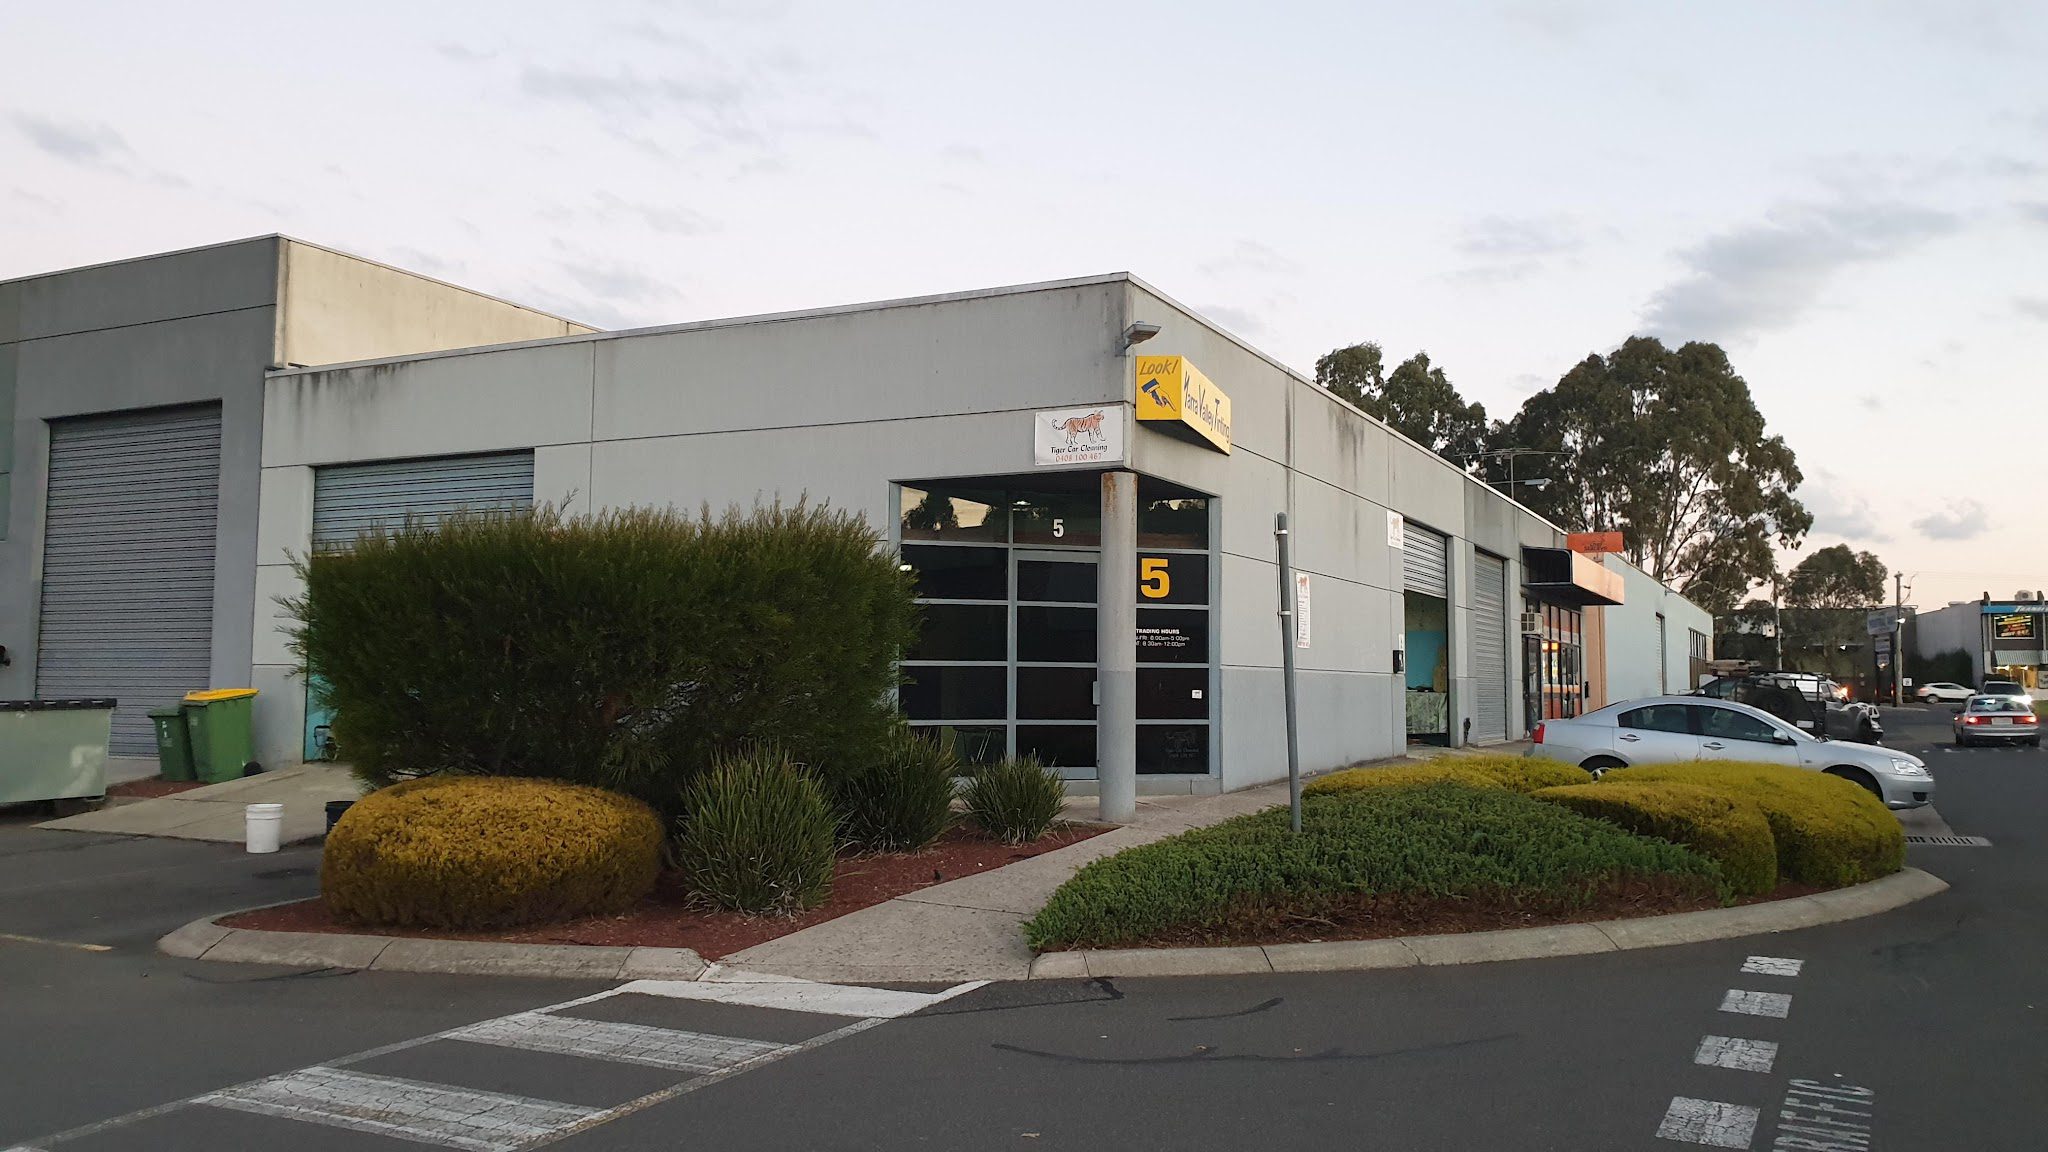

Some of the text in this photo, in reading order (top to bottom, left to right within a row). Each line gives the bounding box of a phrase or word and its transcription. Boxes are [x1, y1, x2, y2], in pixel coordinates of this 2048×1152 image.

[1051, 446, 1065, 455] Tiger
[1080, 444, 1108, 453] Cleaning
[1053, 519, 1064, 538] 5
[1141, 558, 1170, 598] 5
